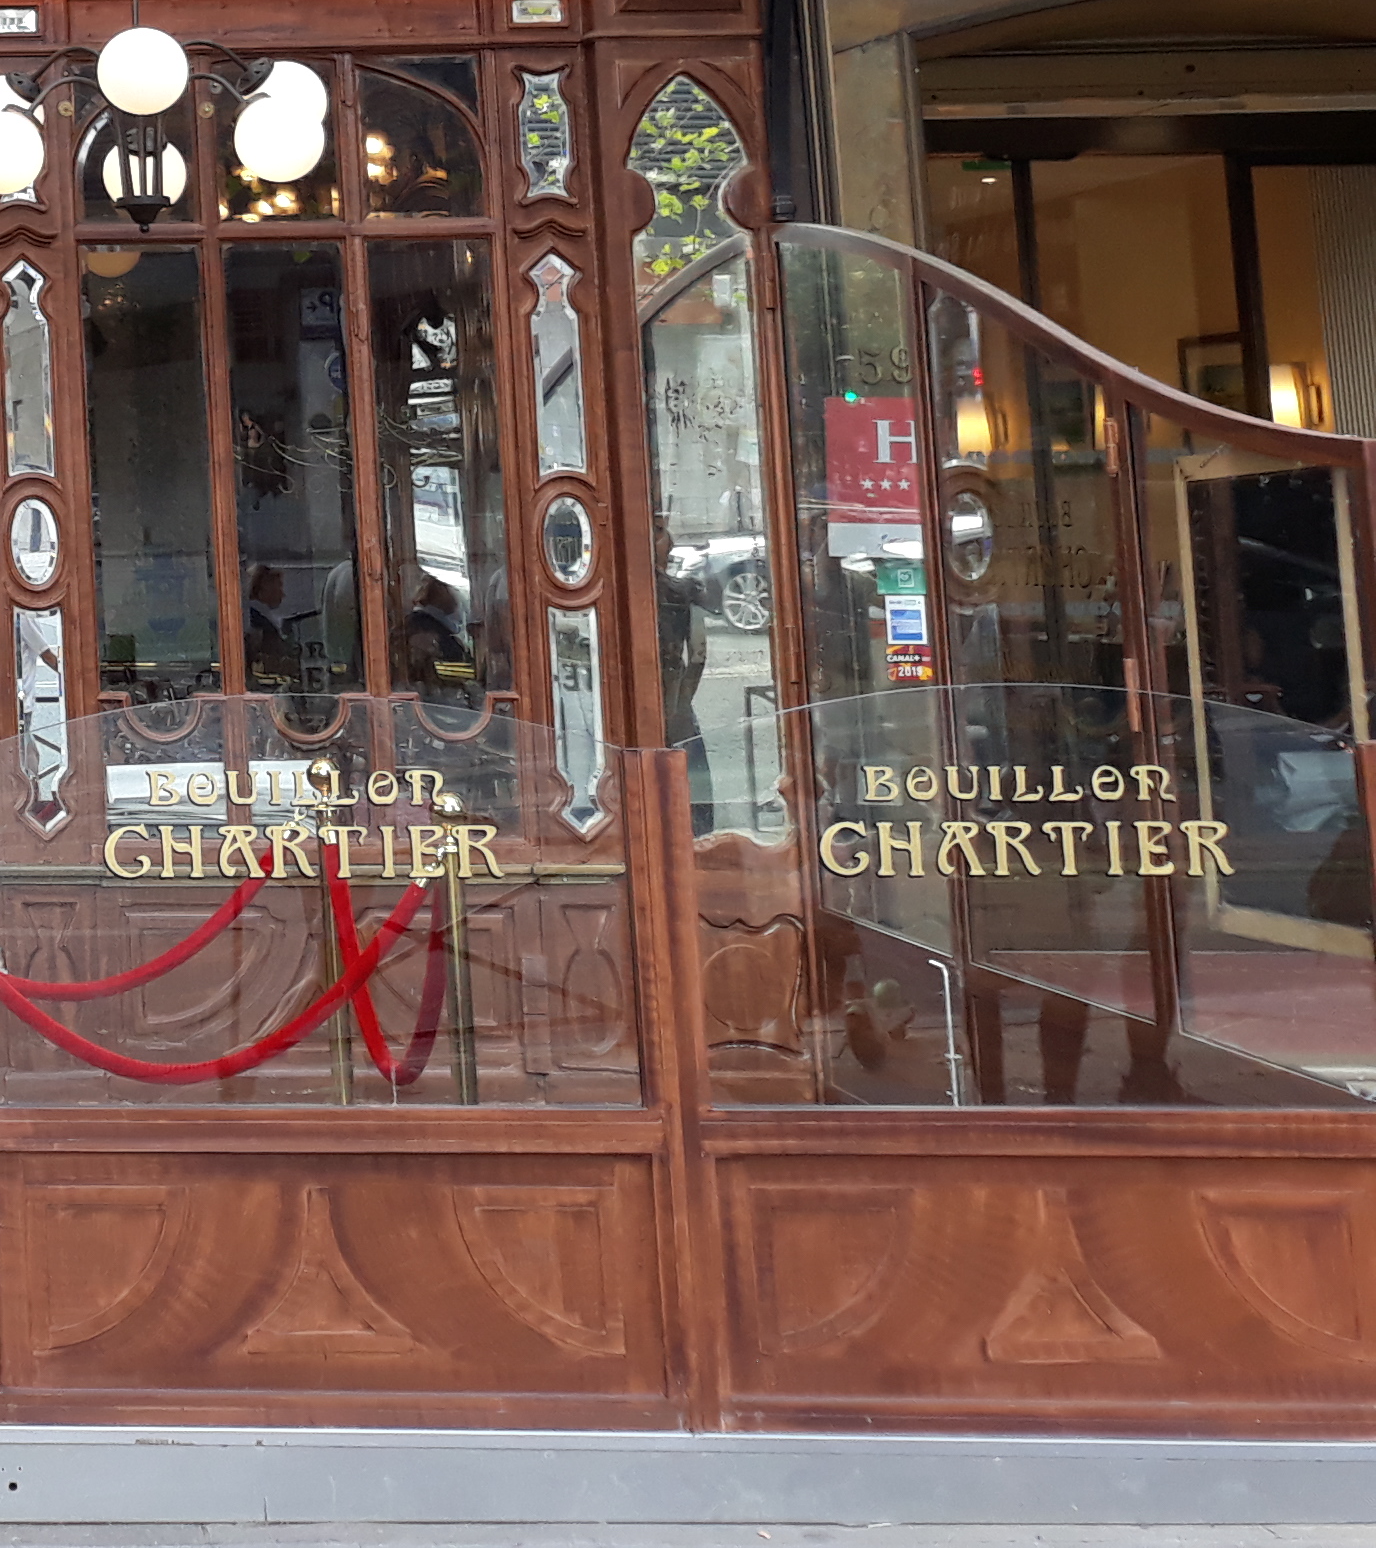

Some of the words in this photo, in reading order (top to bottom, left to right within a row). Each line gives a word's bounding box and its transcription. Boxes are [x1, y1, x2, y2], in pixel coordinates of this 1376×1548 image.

[857, 346, 914, 385] 59
[872, 419, 919, 464] H
[887, 654, 921, 663] CANAL+
[146, 768, 447, 807] BOUILLON
[861, 764, 1178, 803] BOUILLON
[103, 823, 506, 880] CHARTIER
[818, 820, 1237, 877] CHARTIER
